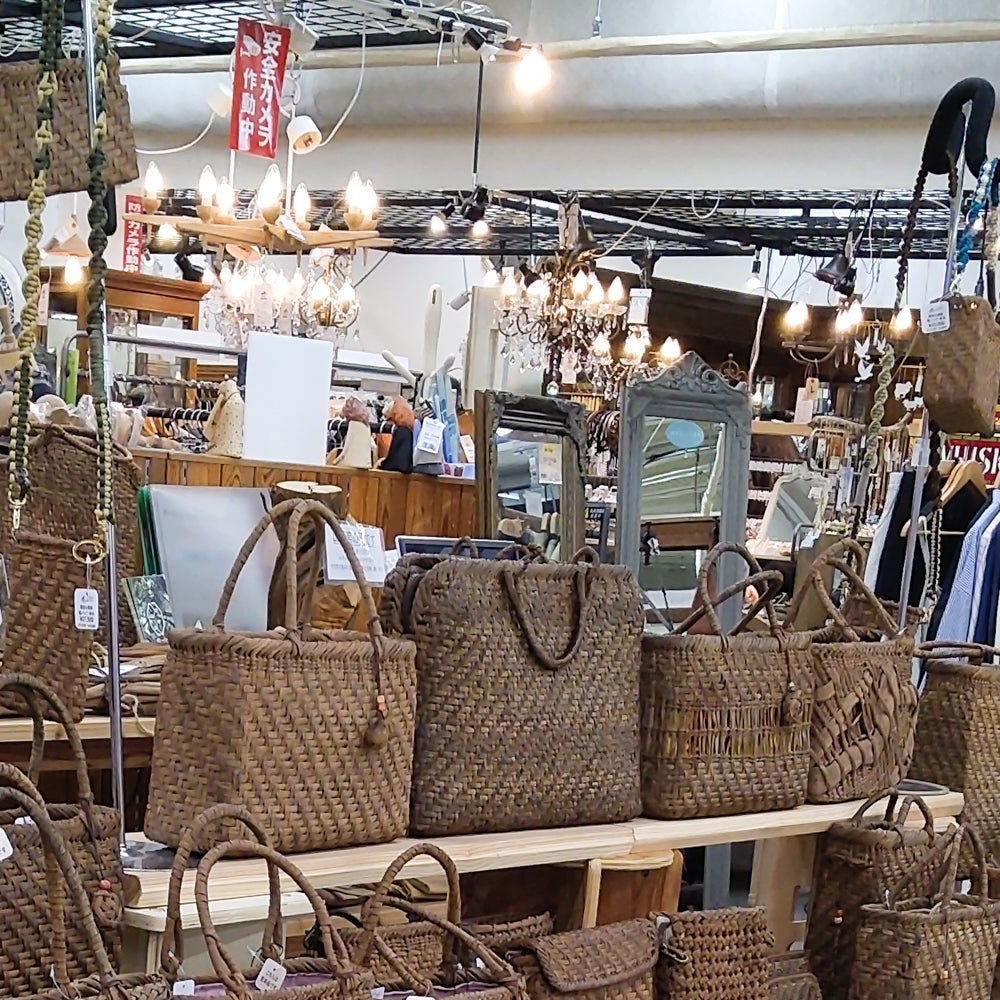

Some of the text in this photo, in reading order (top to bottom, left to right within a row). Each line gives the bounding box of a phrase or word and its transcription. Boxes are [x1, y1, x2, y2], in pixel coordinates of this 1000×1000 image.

[239, 69, 258, 139] 作動中
[257, 30, 284, 147] 安全カメラ
[124, 202, 141, 273] 防カメラ作動中
